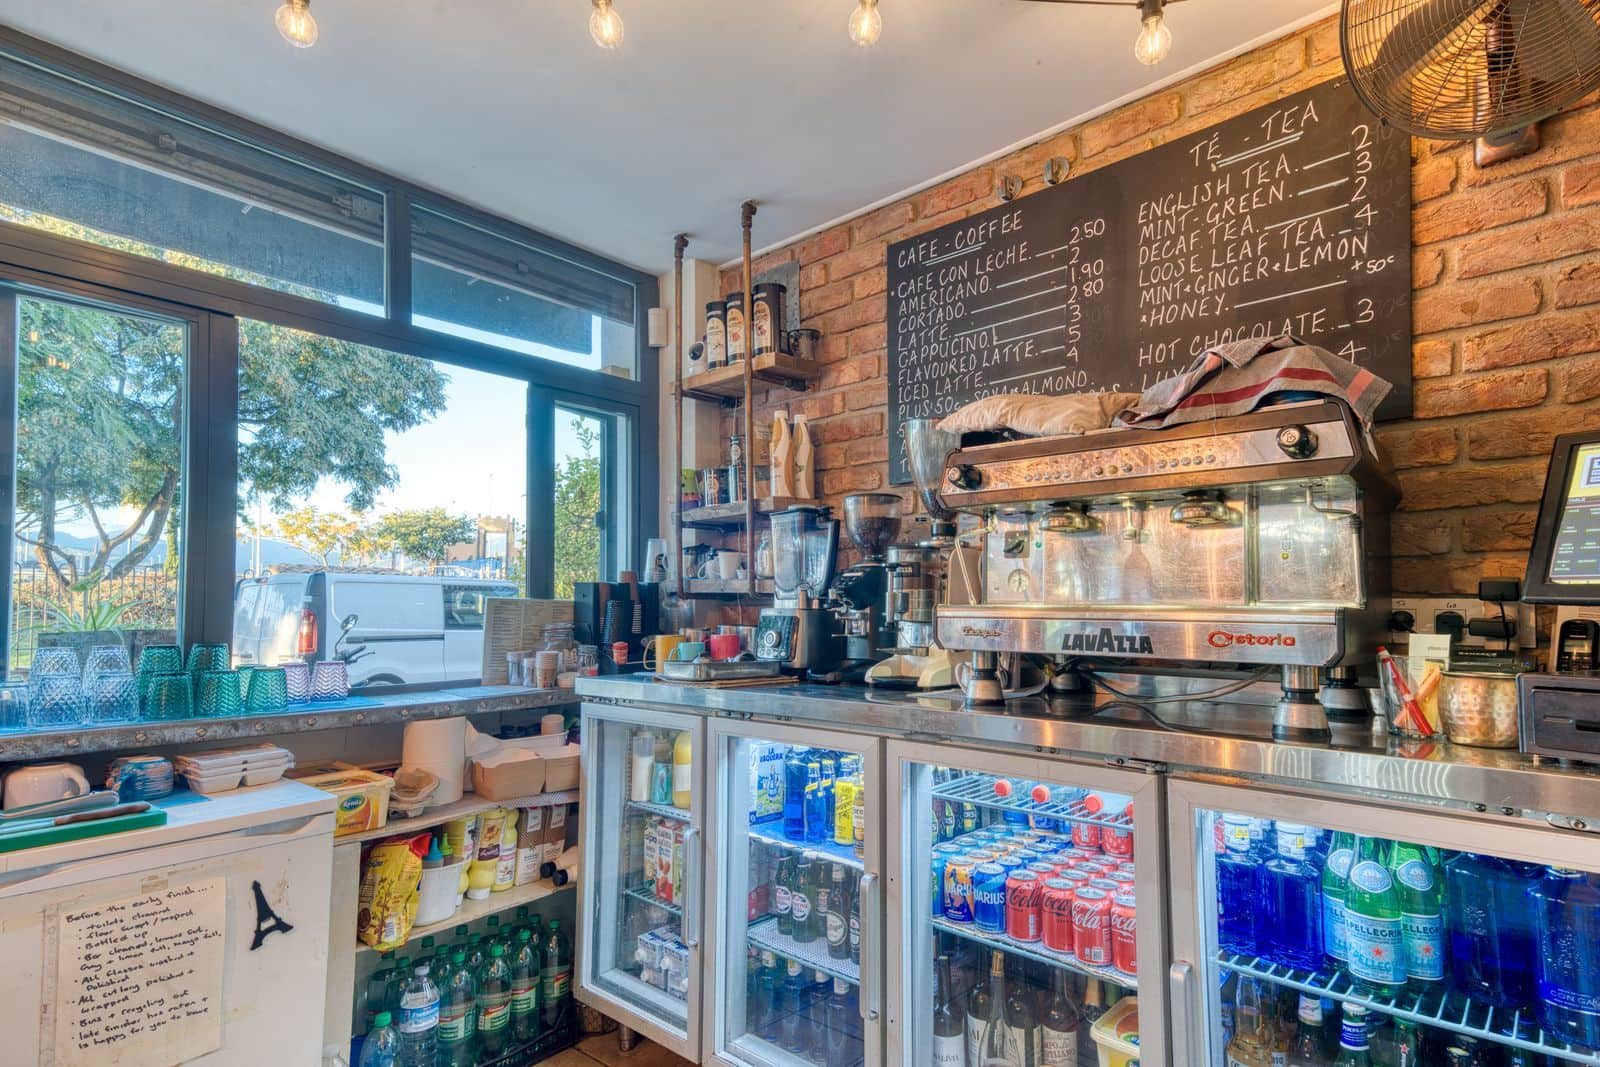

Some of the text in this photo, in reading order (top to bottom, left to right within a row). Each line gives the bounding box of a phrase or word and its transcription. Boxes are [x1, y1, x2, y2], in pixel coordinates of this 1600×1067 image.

[1261, 100, 1319, 141] TEA
[1138, 174, 1230, 224] ENGLISH
[1352, 124, 1373, 152] 2
[1356, 151, 1373, 174] 3
[1351, 176, 1368, 202] 2
[898, 240, 938, 269] CAFE
[954, 210, 1023, 250] COFFEE
[1139, 257, 1202, 288] LOOSE
[1211, 232, 1270, 268] LEAF
[1354, 203, 1380, 226] 4
[897, 272, 934, 299] CAFE
[939, 261, 969, 285] CON
[1069, 218, 1106, 245] 2.50
[1069, 246, 1081, 265] 2
[1069, 258, 1105, 284] 1.90
[1069, 278, 1104, 305] 2.80
[1069, 304, 1082, 323] 3
[1138, 338, 1182, 367] HOT
[1355, 298, 1375, 323] 3
[898, 355, 978, 387] FLAVOURED
[1068, 324, 1082, 344] 5
[1337, 340, 1368, 364] 4
[898, 384, 929, 404] ICED
[1067, 346, 1079, 362] 4
[1062, 627, 1154, 654] LAVAZZA
[107, 905, 126, 913] the
[132, 896, 162, 908] early
[134, 931, 148, 940] up
[172, 989, 190, 999] out
[93, 1032, 127, 1047] happy
[149, 1020, 168, 1031] you
